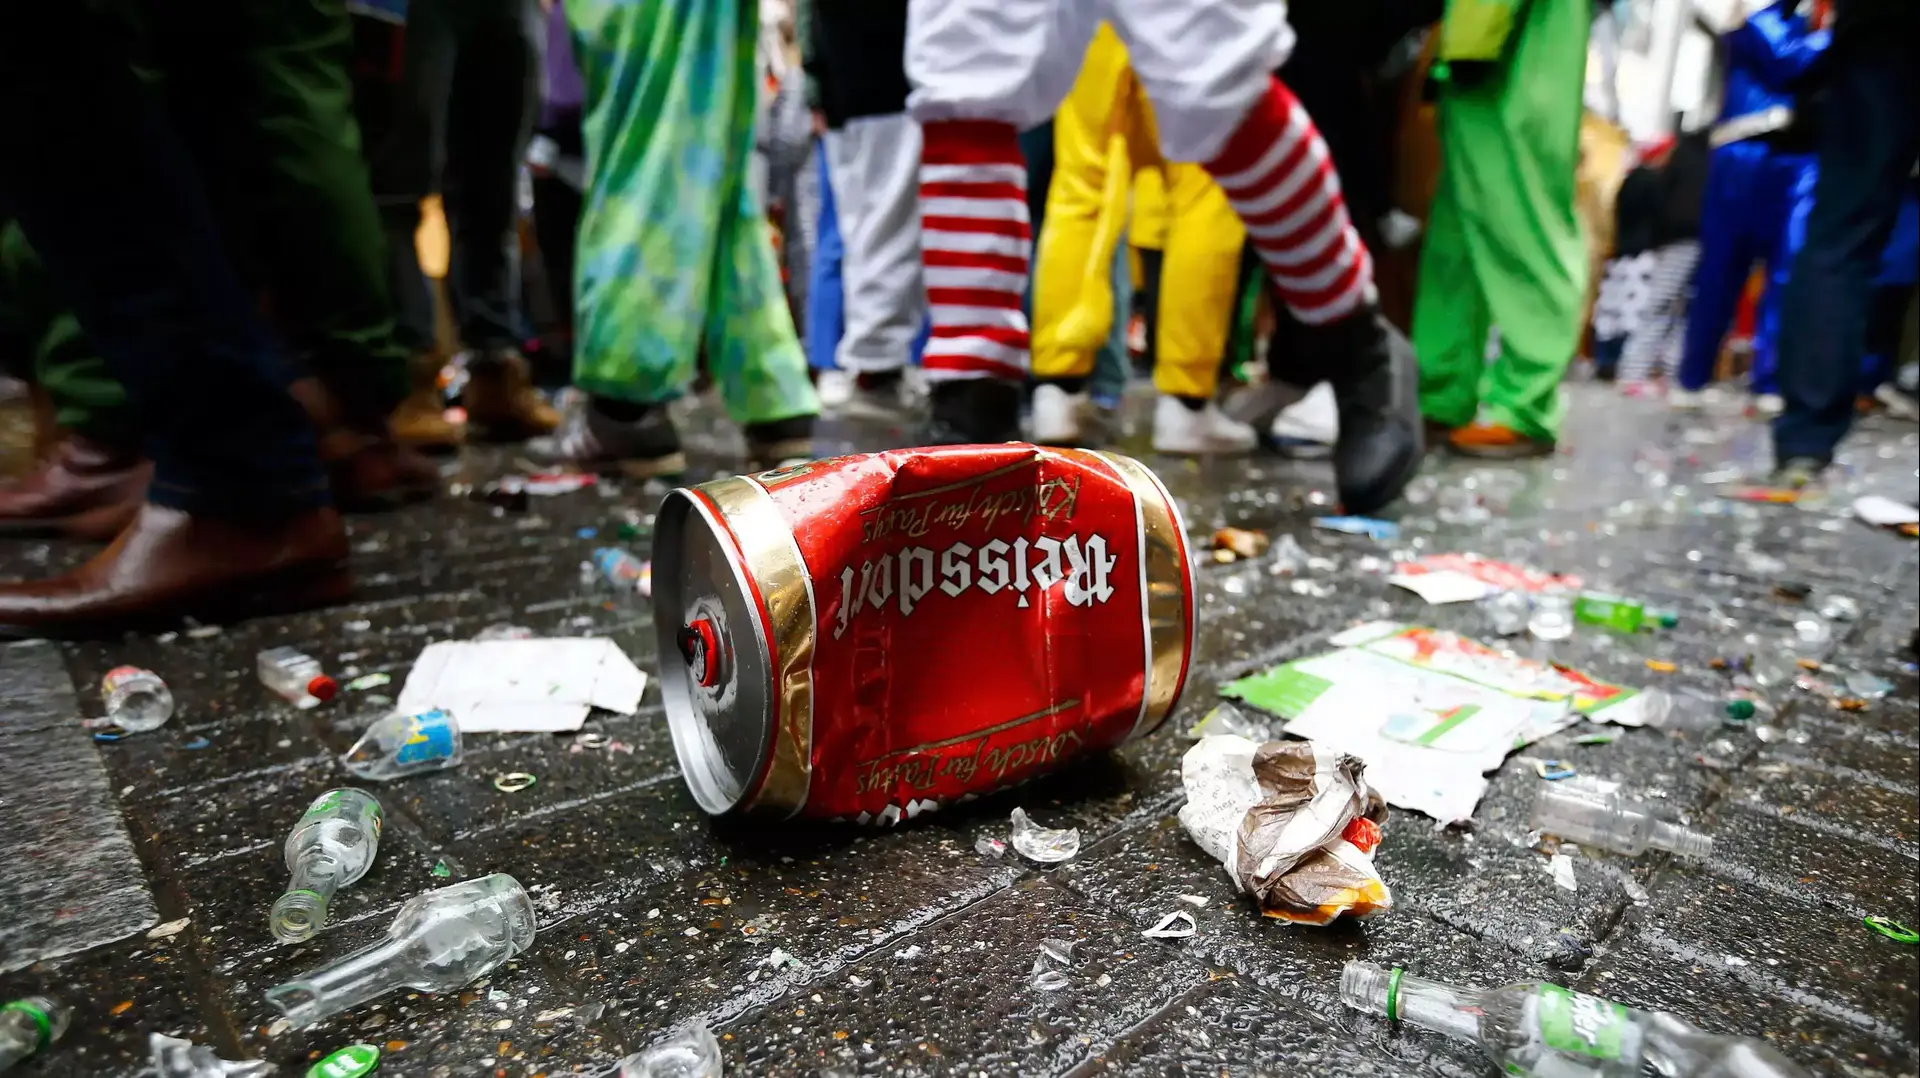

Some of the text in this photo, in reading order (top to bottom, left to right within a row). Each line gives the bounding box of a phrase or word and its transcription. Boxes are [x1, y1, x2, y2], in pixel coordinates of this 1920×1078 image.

[934, 485, 982, 531] für
[833, 533, 1117, 640] Reissdorf
[940, 736, 987, 784] für
